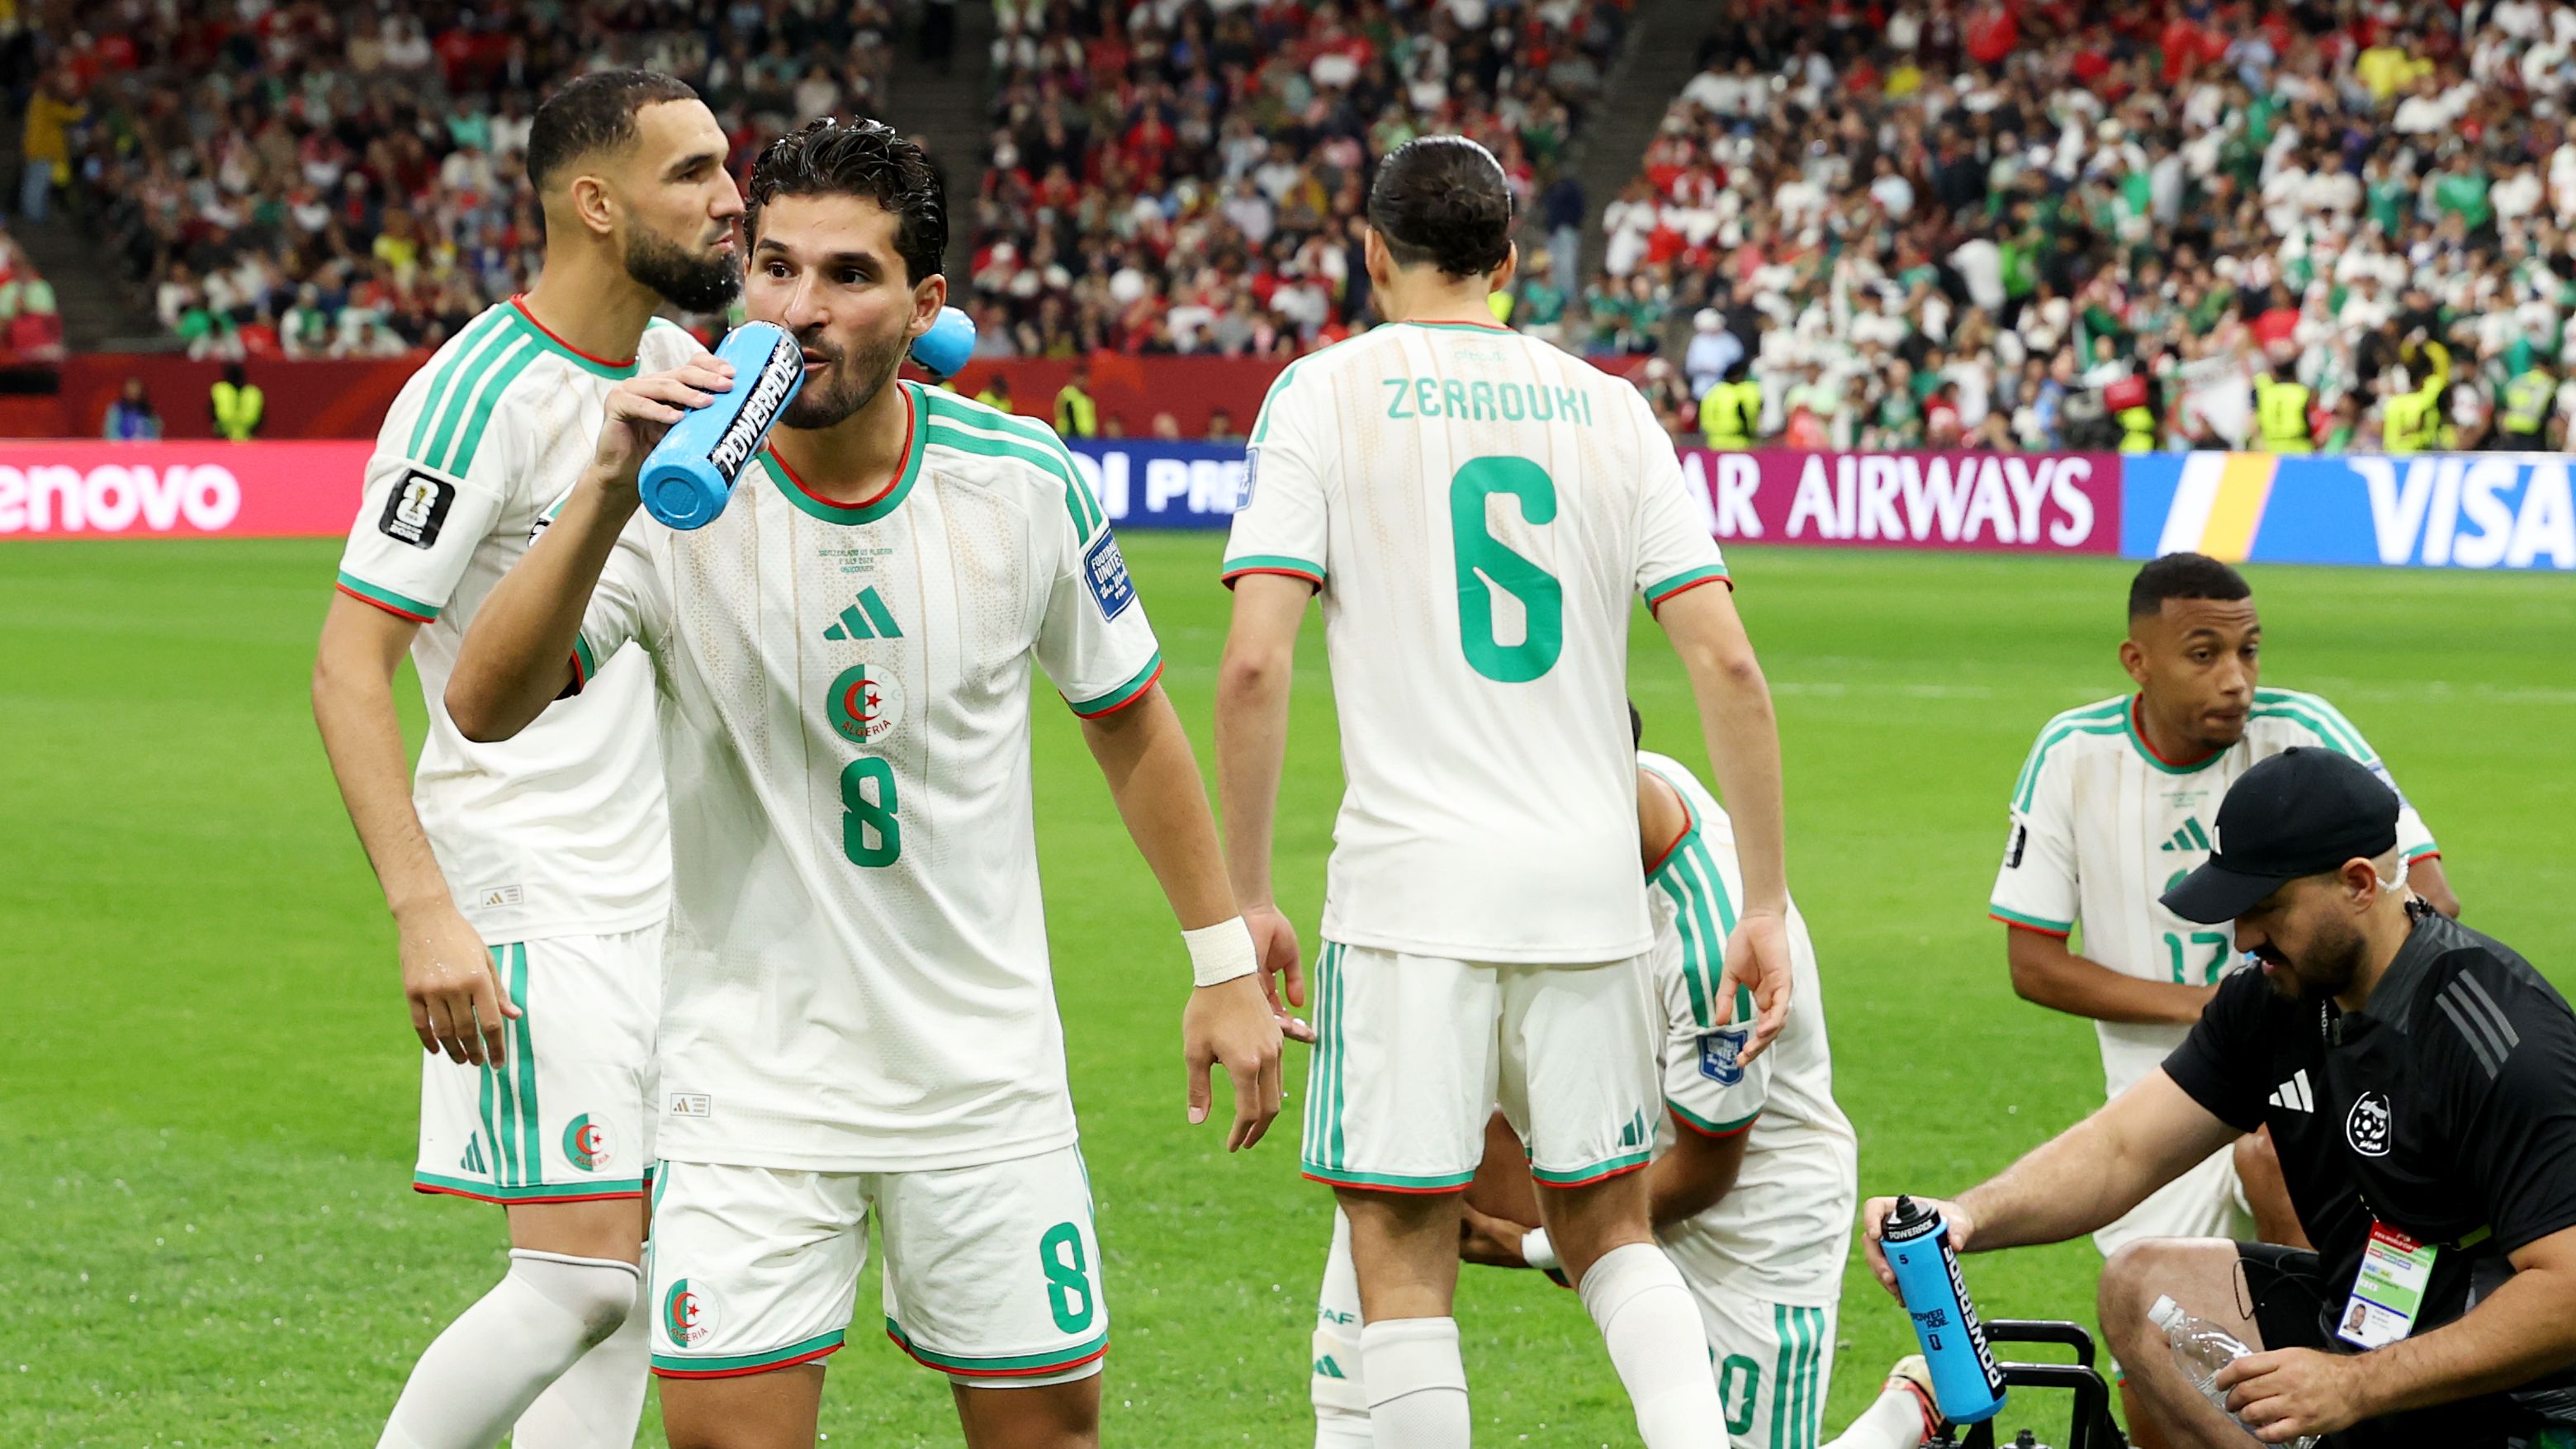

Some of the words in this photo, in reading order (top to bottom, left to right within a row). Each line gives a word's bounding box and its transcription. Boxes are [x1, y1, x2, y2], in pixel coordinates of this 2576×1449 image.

[713, 347, 798, 476] POWERADE
[1382, 377, 1593, 427] ZERROUKI
[1785, 453, 2095, 547] AIRWAYS
[2346, 455, 2576, 570] VISA
[1450, 456, 1563, 683] 6
[841, 719, 893, 737] ALGERIA
[841, 756, 901, 868] 8
[2163, 932, 2228, 986] 17
[1888, 1219, 1934, 1240] POWERADE
[1899, 1253, 1910, 1264] 5
[1039, 1222, 1093, 1334] 8
[670, 1327, 709, 1342] ALGERIA
[1708, 1346, 1760, 1436] 0
